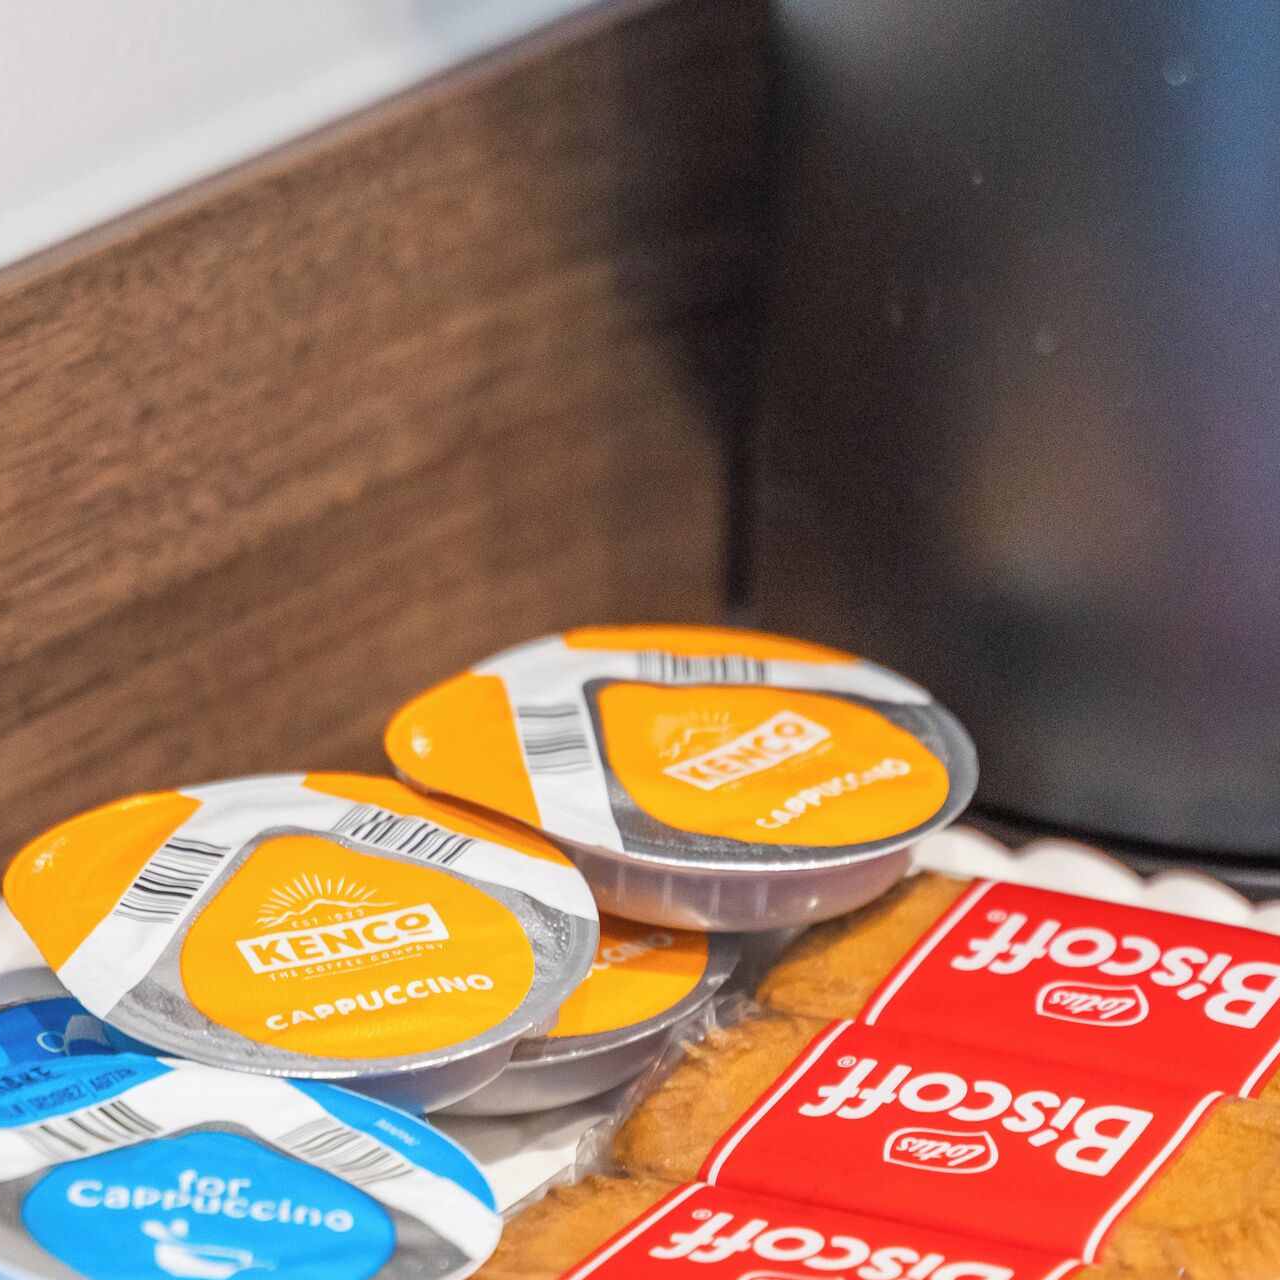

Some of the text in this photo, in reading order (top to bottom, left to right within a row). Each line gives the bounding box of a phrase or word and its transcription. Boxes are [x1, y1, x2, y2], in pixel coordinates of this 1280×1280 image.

[675, 718, 810, 785] KENCO
[248, 912, 432, 968] KENCO
[269, 943, 444, 982] THE COFFEE COMPANY
[265, 973, 495, 1031] CAPPUCCINO
[1046, 988, 1137, 1019] Lotus
[895, 1134, 987, 1167] Lotus
[66, 1178, 355, 1233] Cappuccino
[178, 1168, 251, 1199] for
